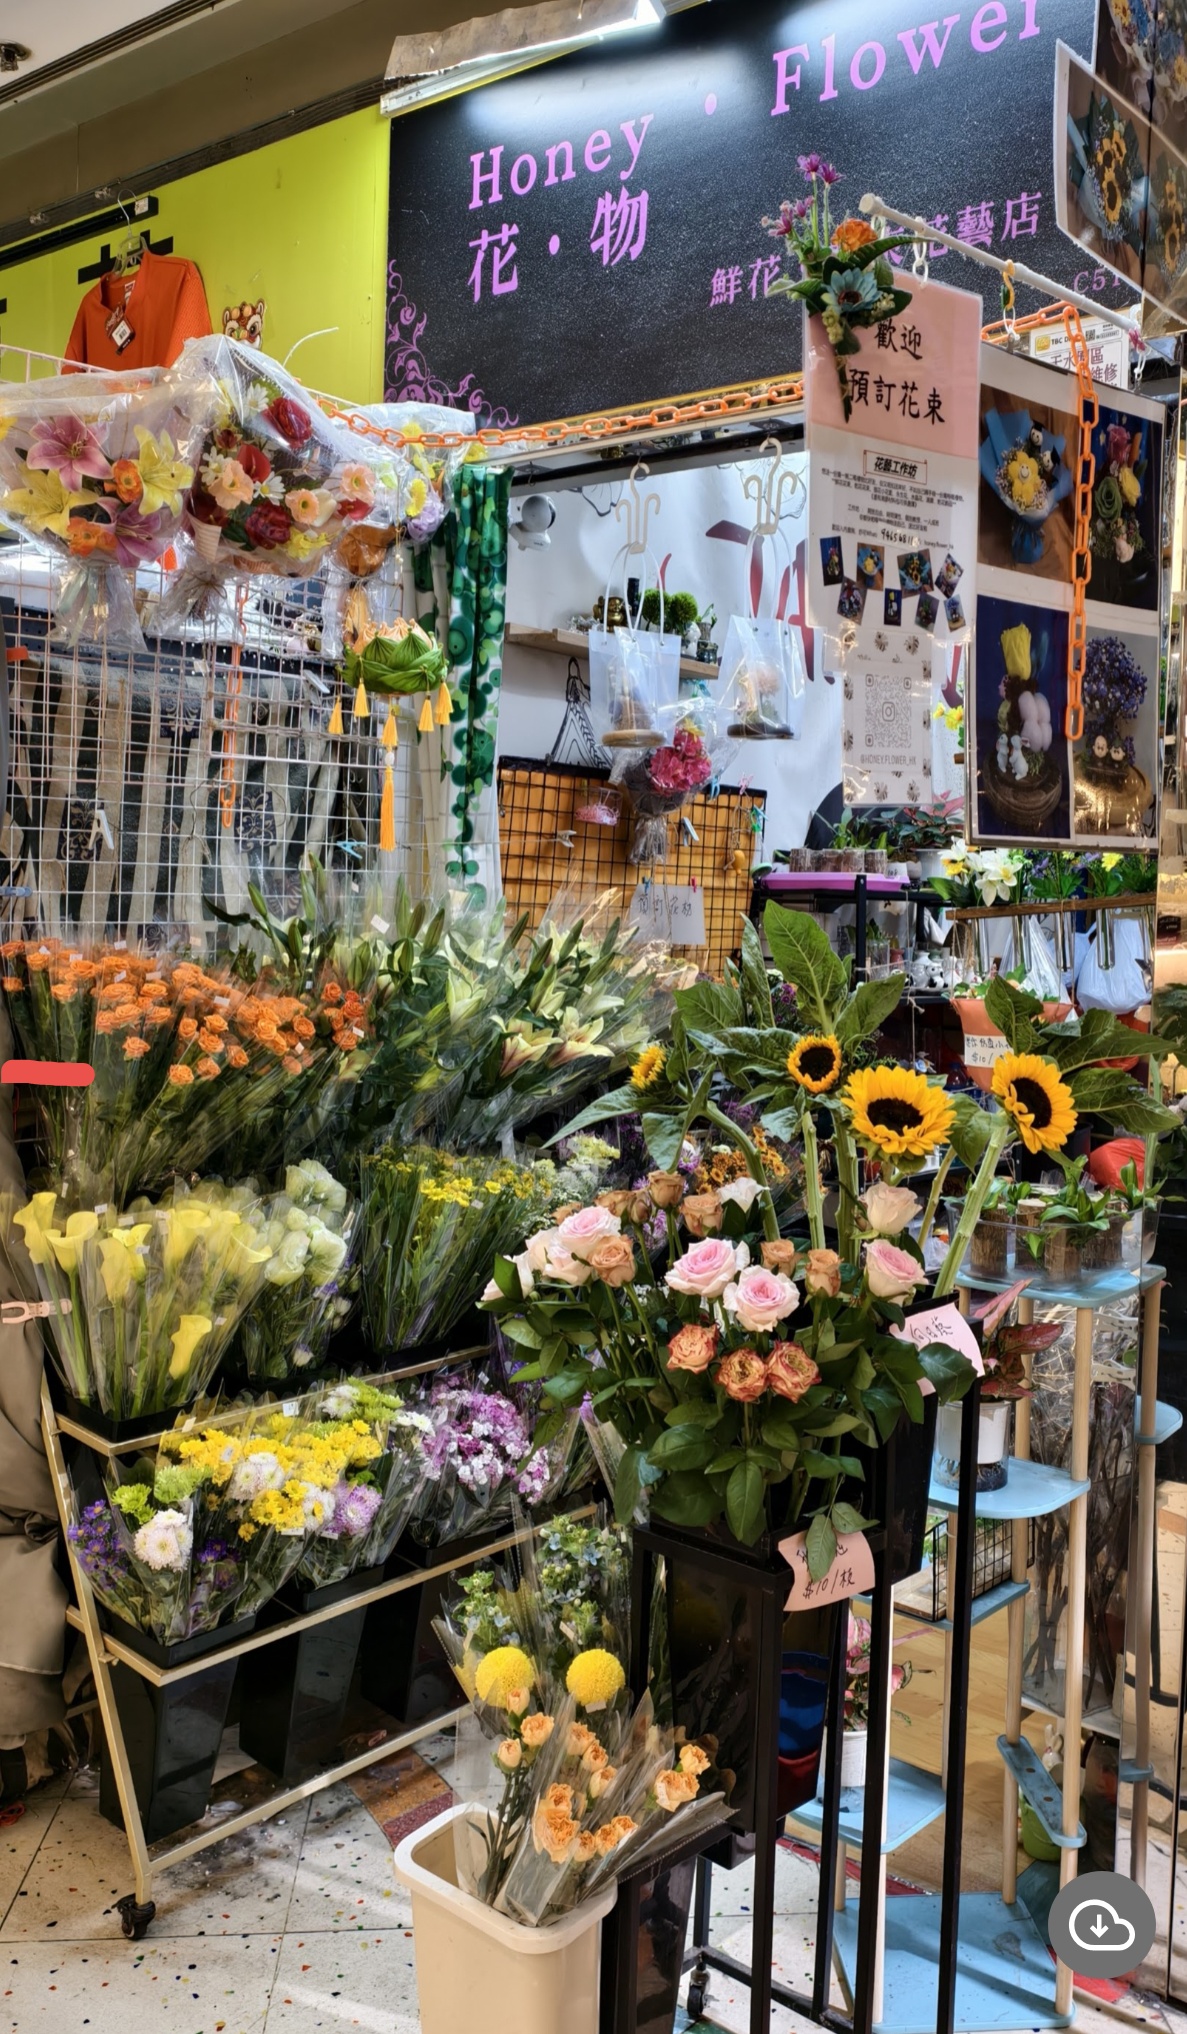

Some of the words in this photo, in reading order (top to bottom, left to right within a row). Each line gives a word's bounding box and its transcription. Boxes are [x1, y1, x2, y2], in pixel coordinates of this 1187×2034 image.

[468, 113, 654, 210] Honey
[874, 318, 923, 360] 歡迎
[1051, 337, 1063, 346] TBC
[848, 368, 945, 425] 預訂花束
